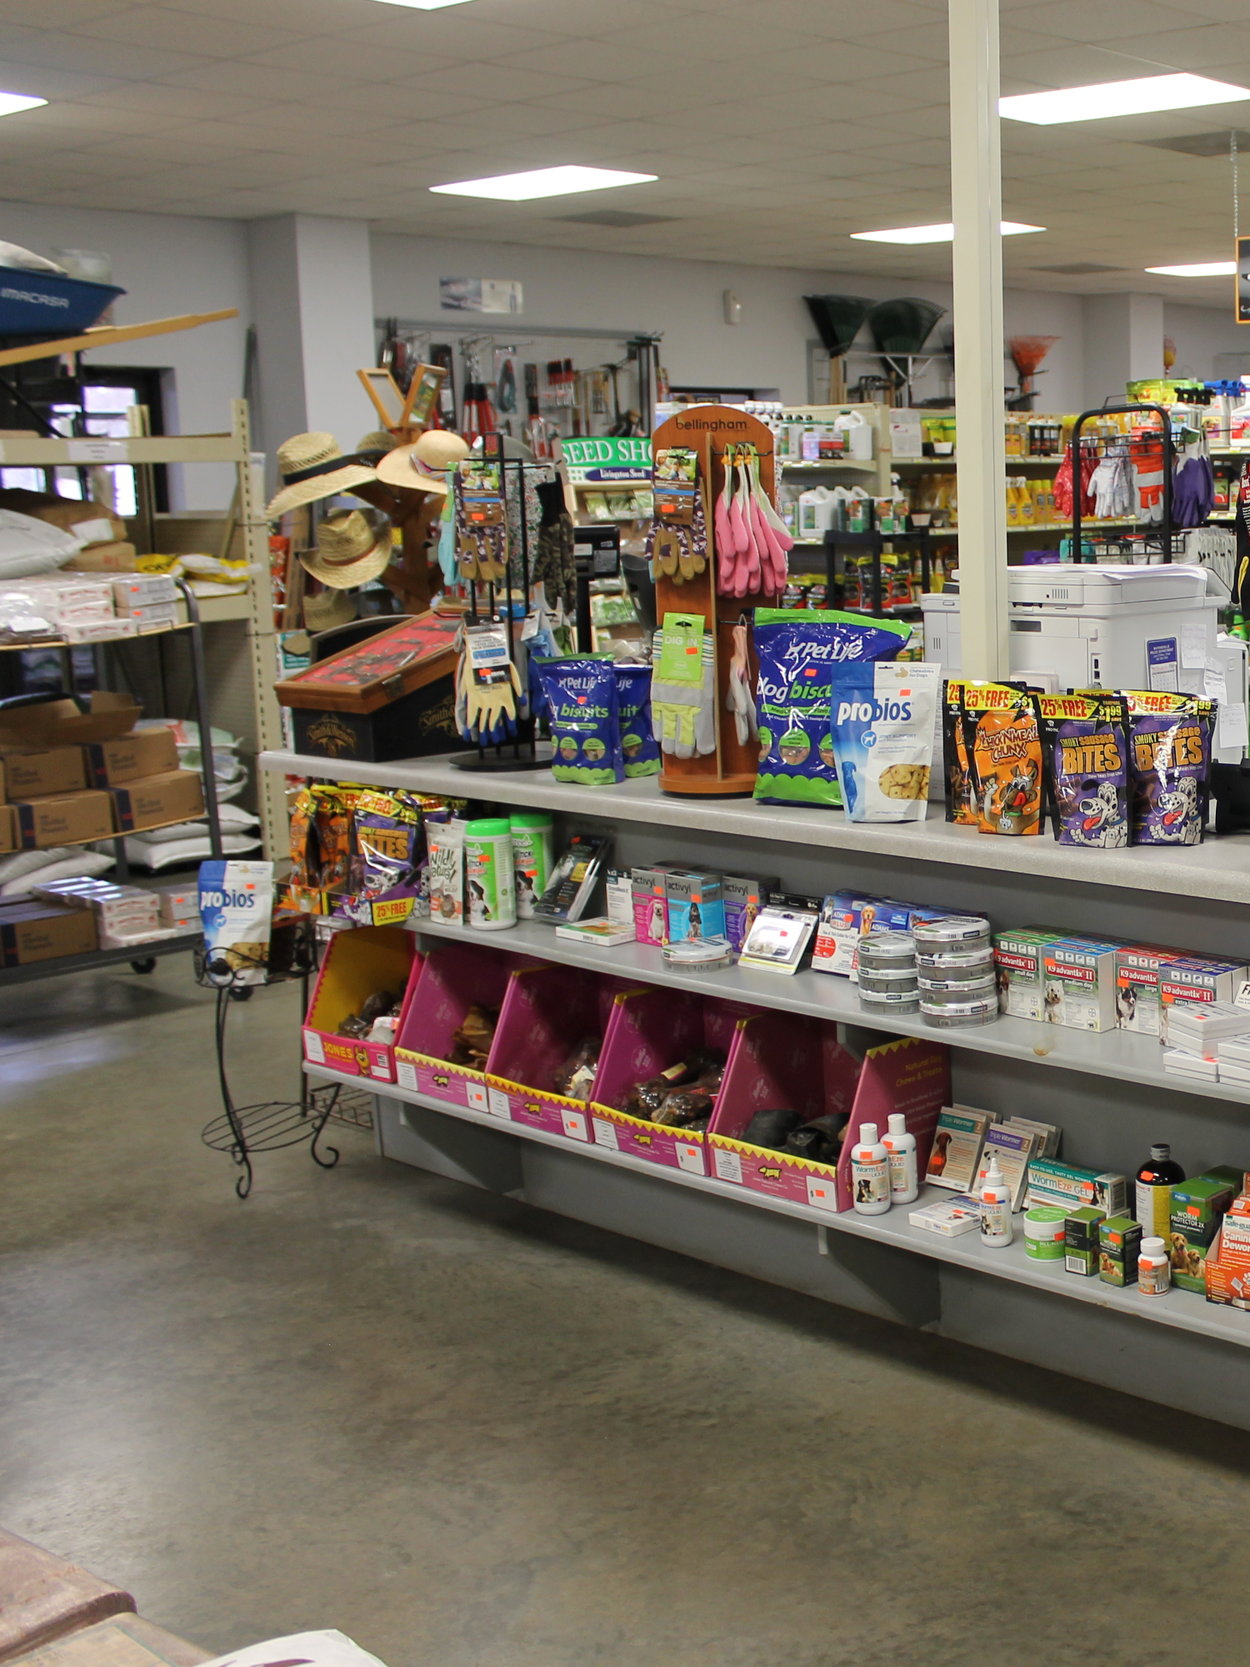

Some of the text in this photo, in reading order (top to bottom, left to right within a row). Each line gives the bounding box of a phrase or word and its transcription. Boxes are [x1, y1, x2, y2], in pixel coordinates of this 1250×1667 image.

[676, 416, 747, 432] bellingham
[561, 440, 613, 464] SEED
[600, 468, 646, 480] Livingston Seed
[664, 636, 683, 645] DIG
[802, 642, 830, 660] Pet
[568, 677, 582, 689] Pet
[756, 676, 790, 704] dog
[986, 690, 1010, 708] FREE
[1144, 696, 1172, 712] FREE
[560, 704, 609, 719] biscuits
[837, 698, 913, 726] probios
[1040, 699, 1088, 718] 25% FREE
[1134, 734, 1158, 744] SMOKY
[1062, 744, 1122, 775] BITES
[632, 874, 656, 889] activyl
[668, 880, 692, 894] activyl
[724, 883, 749, 896] activyl
[390, 902, 406, 914] FREE
[871, 922, 891, 932] ADAMS
[1002, 956, 1034, 970] advantix II
[1026, 972, 1035, 980] dog
[1056, 966, 1093, 980] advantix II
[1120, 969, 1158, 982] K9 advantix
[1064, 979, 1093, 990] medium dog
[1162, 985, 1212, 1001] K9 advantix II
[952, 1116, 974, 1128] Wormer
[1000, 1132, 1021, 1144] Wormer
[854, 1164, 888, 1174] WormEze
[1032, 1172, 1072, 1192] WormEze
[1170, 1216, 1198, 1228] PROTECTOR
[1176, 1210, 1198, 1221] WORM
